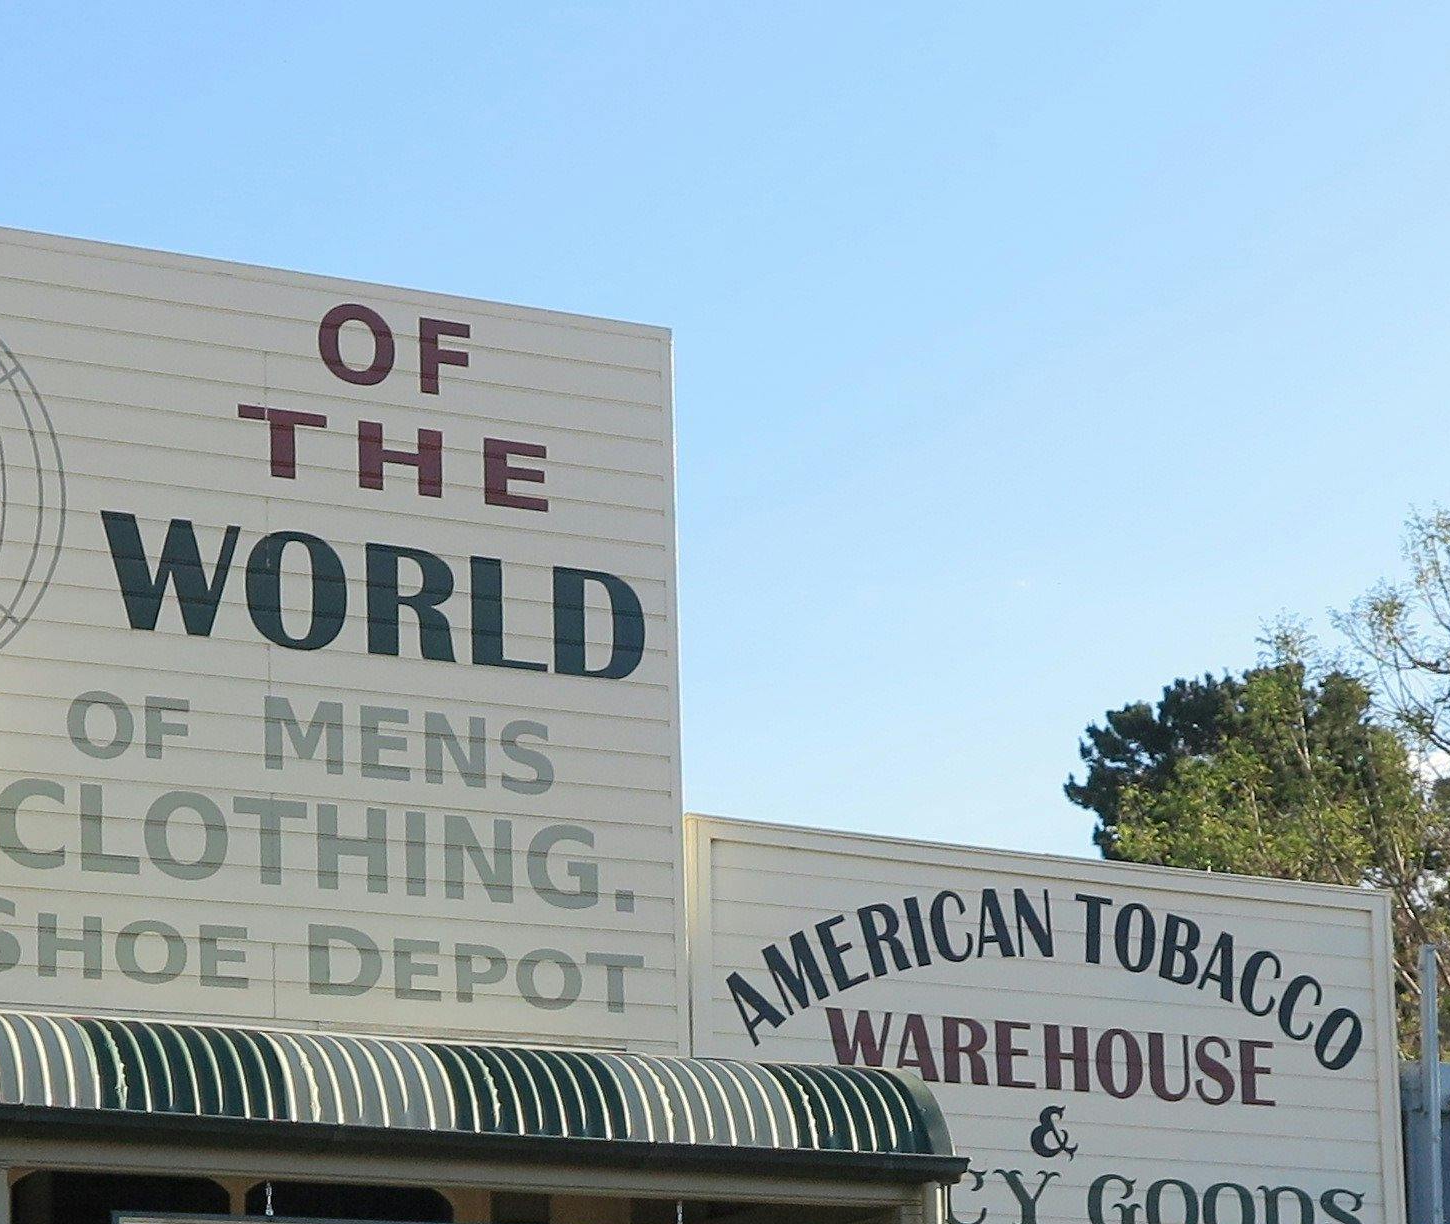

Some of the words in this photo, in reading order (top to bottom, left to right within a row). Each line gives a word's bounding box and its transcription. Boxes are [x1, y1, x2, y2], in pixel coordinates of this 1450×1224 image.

[318, 302, 471, 394] OF
[237, 404, 549, 514] THE
[100, 510, 645, 680] WORLD
[67, 690, 190, 760] OF
[264, 695, 554, 796] MENS
[307, 923, 646, 1014] DEPOT
[725, 888, 1053, 1047] AMERICAN
[1075, 893, 1363, 1070] TOBACCO
[825, 1007, 1277, 1106] WAREHOUSE
[1030, 1105, 1079, 1161] &
